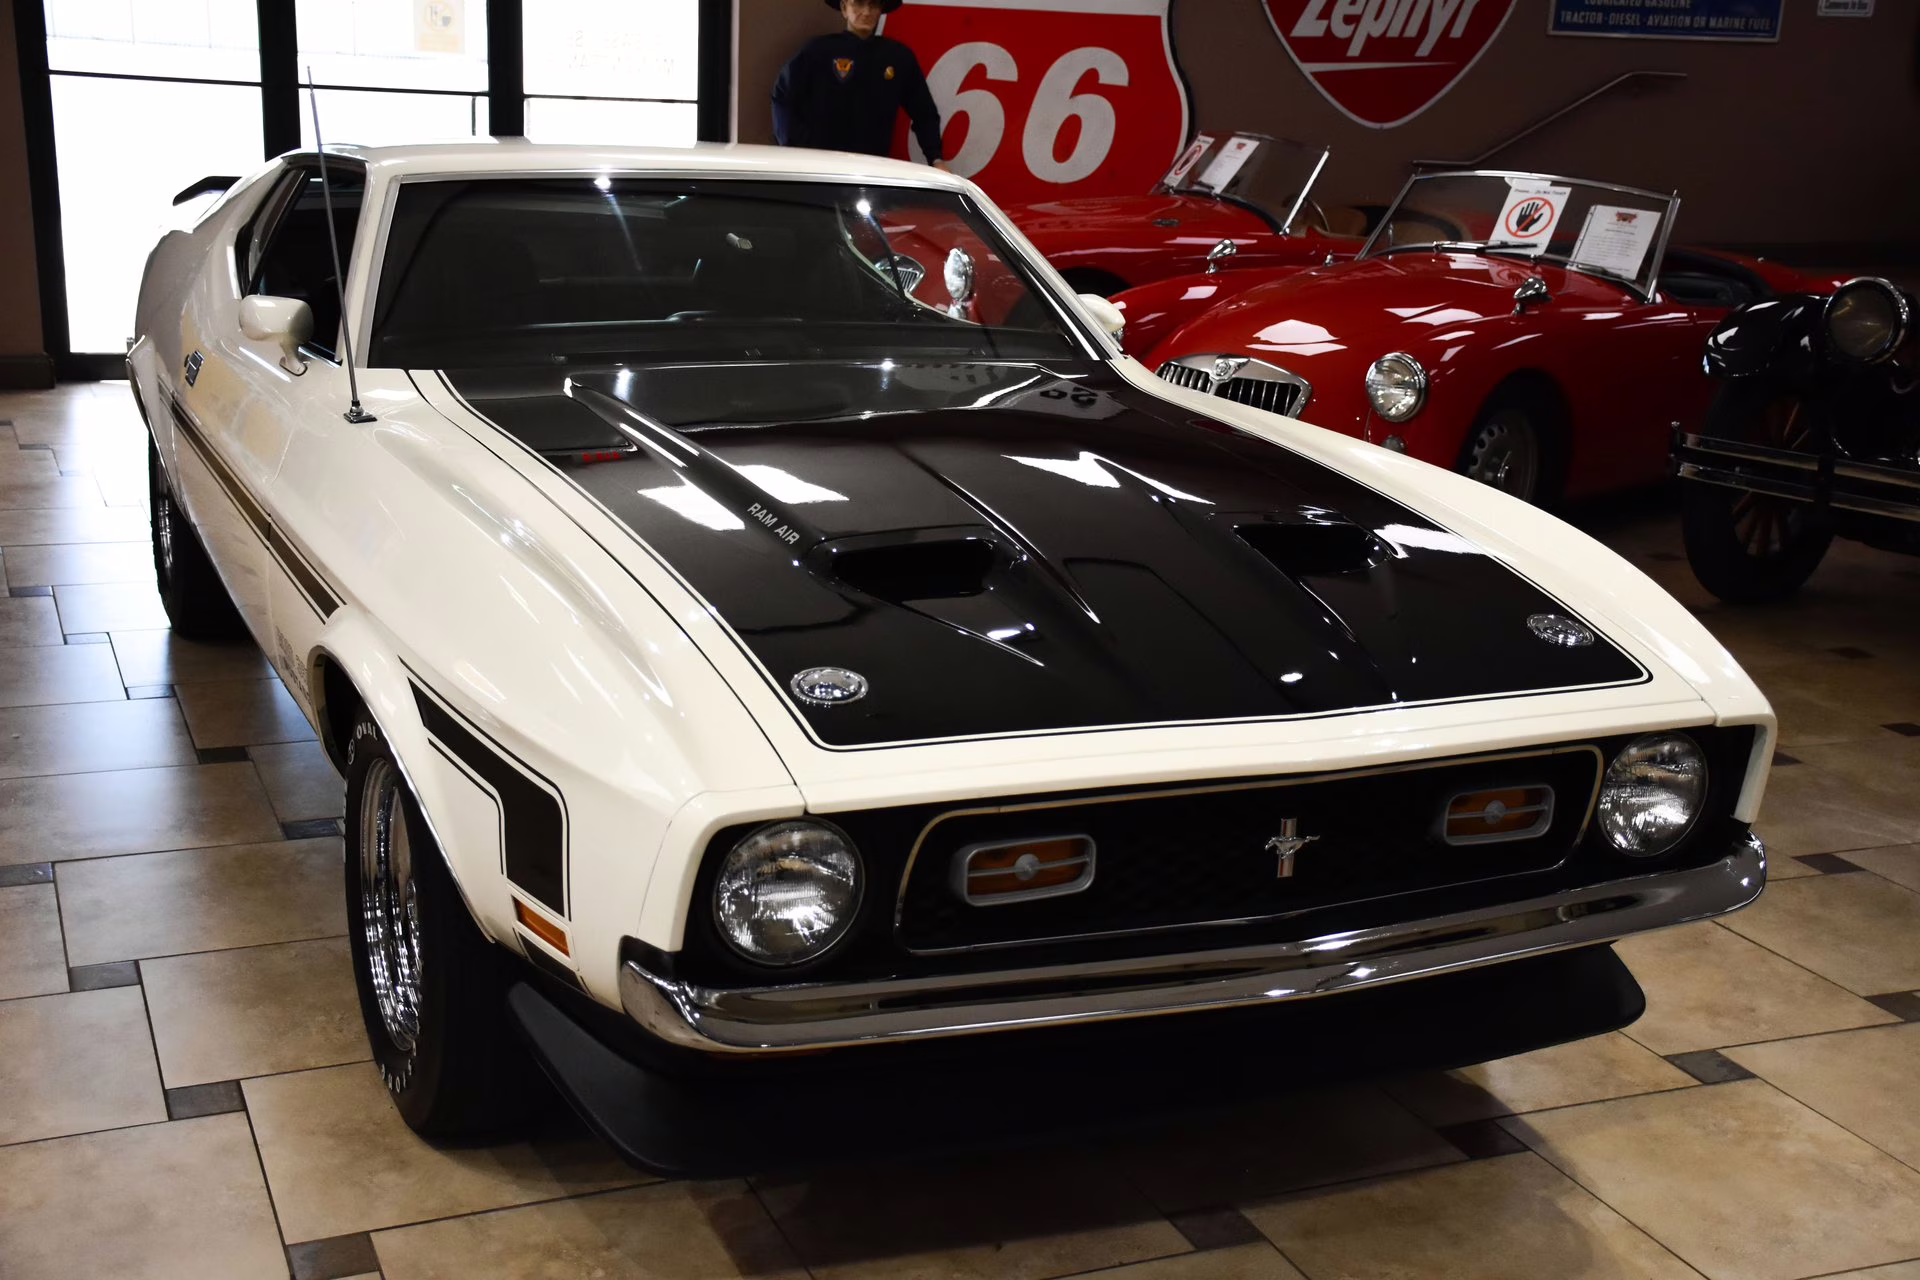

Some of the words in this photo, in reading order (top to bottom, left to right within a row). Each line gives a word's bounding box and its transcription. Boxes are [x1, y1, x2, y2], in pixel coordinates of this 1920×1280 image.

[1289, 0, 1479, 57] Zephyr
[1560, 10, 1604, 24] TRACTOR
[1608, 12, 1641, 26] DIESEL
[1646, 14, 1692, 28] AVIATION
[1692, 16, 1708, 29] OR
[1708, 16, 1747, 30] MARINE
[1747, 18, 1771, 31] FUEL
[907, 41, 1130, 184] 66
[746, 502, 779, 528] RAM
[773, 524, 801, 545] AIR
[356, 721, 378, 741] OVAL
